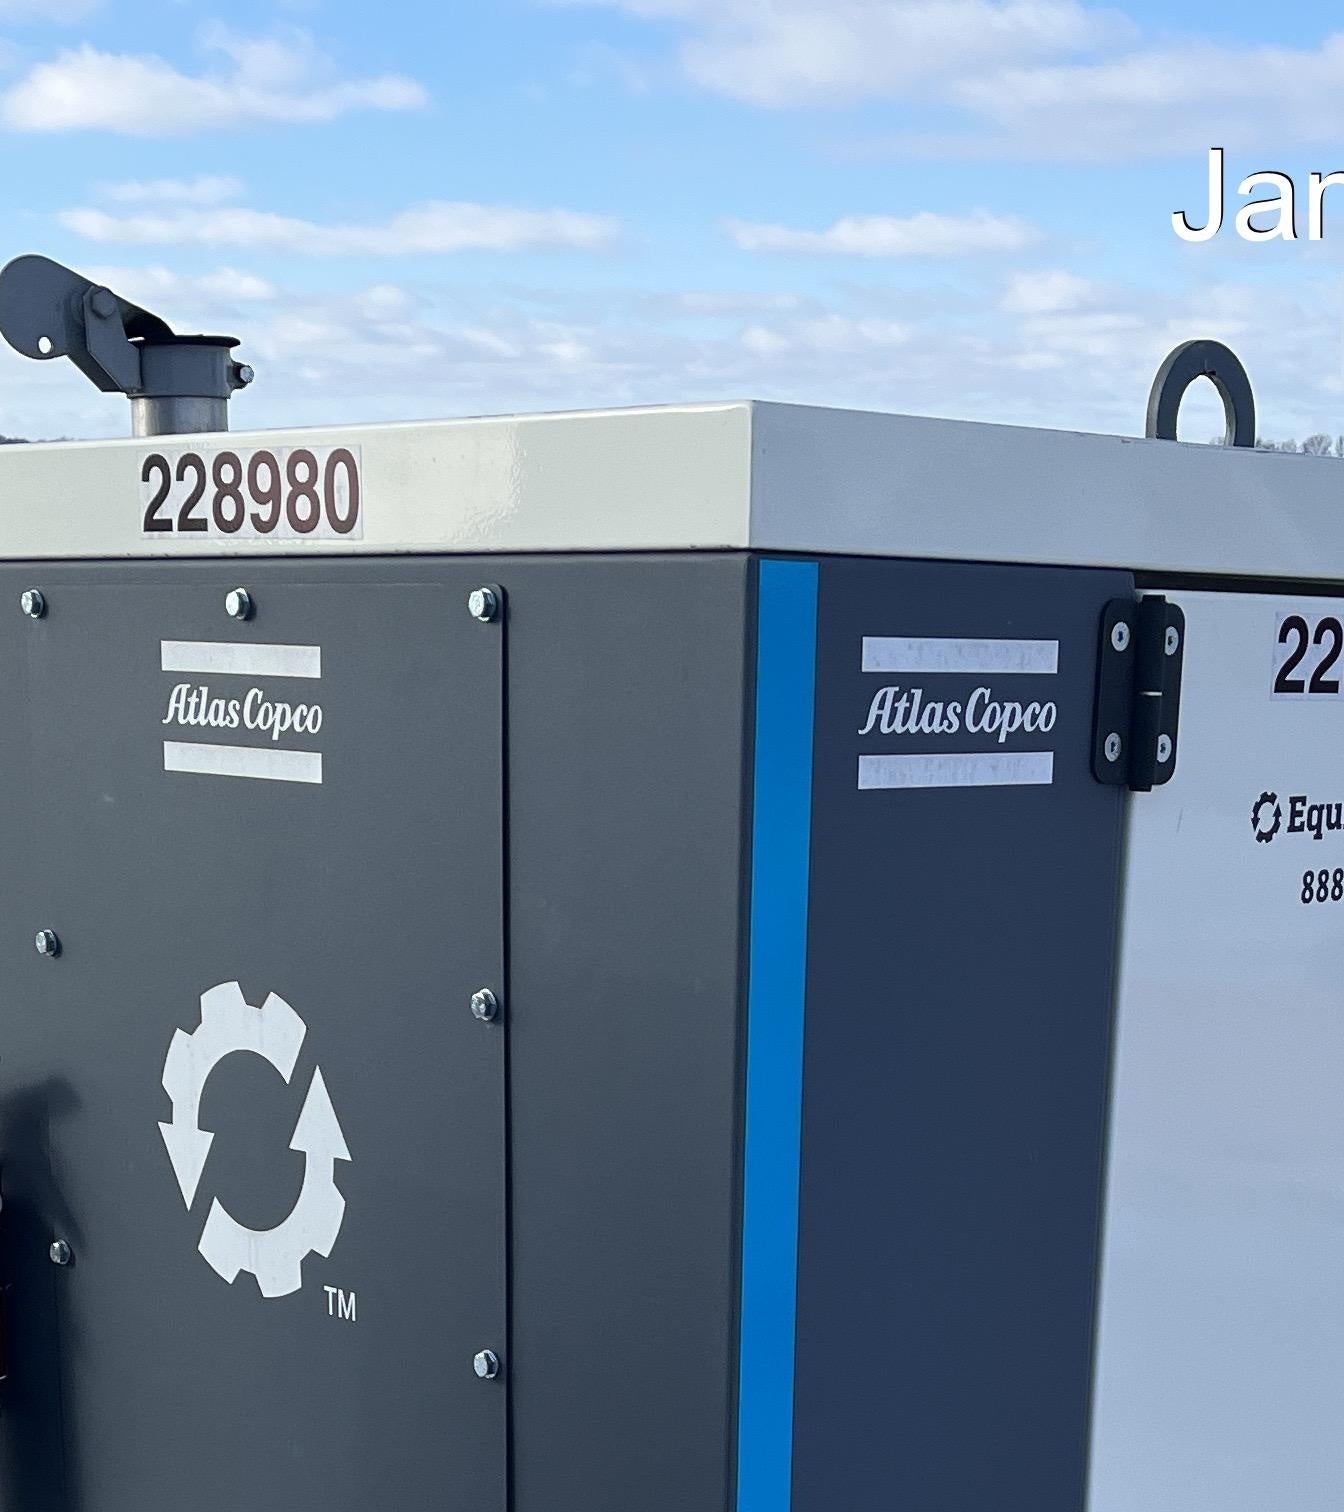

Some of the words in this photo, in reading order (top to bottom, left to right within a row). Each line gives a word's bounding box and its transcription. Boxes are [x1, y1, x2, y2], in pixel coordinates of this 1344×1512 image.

[141, 447, 360, 535] 228980
[162, 683, 241, 729] Atlas
[243, 687, 323, 741] Copco
[857, 686, 962, 735] Atlas
[965, 686, 1057, 744] Copco
[323, 1285, 357, 1322] TM
